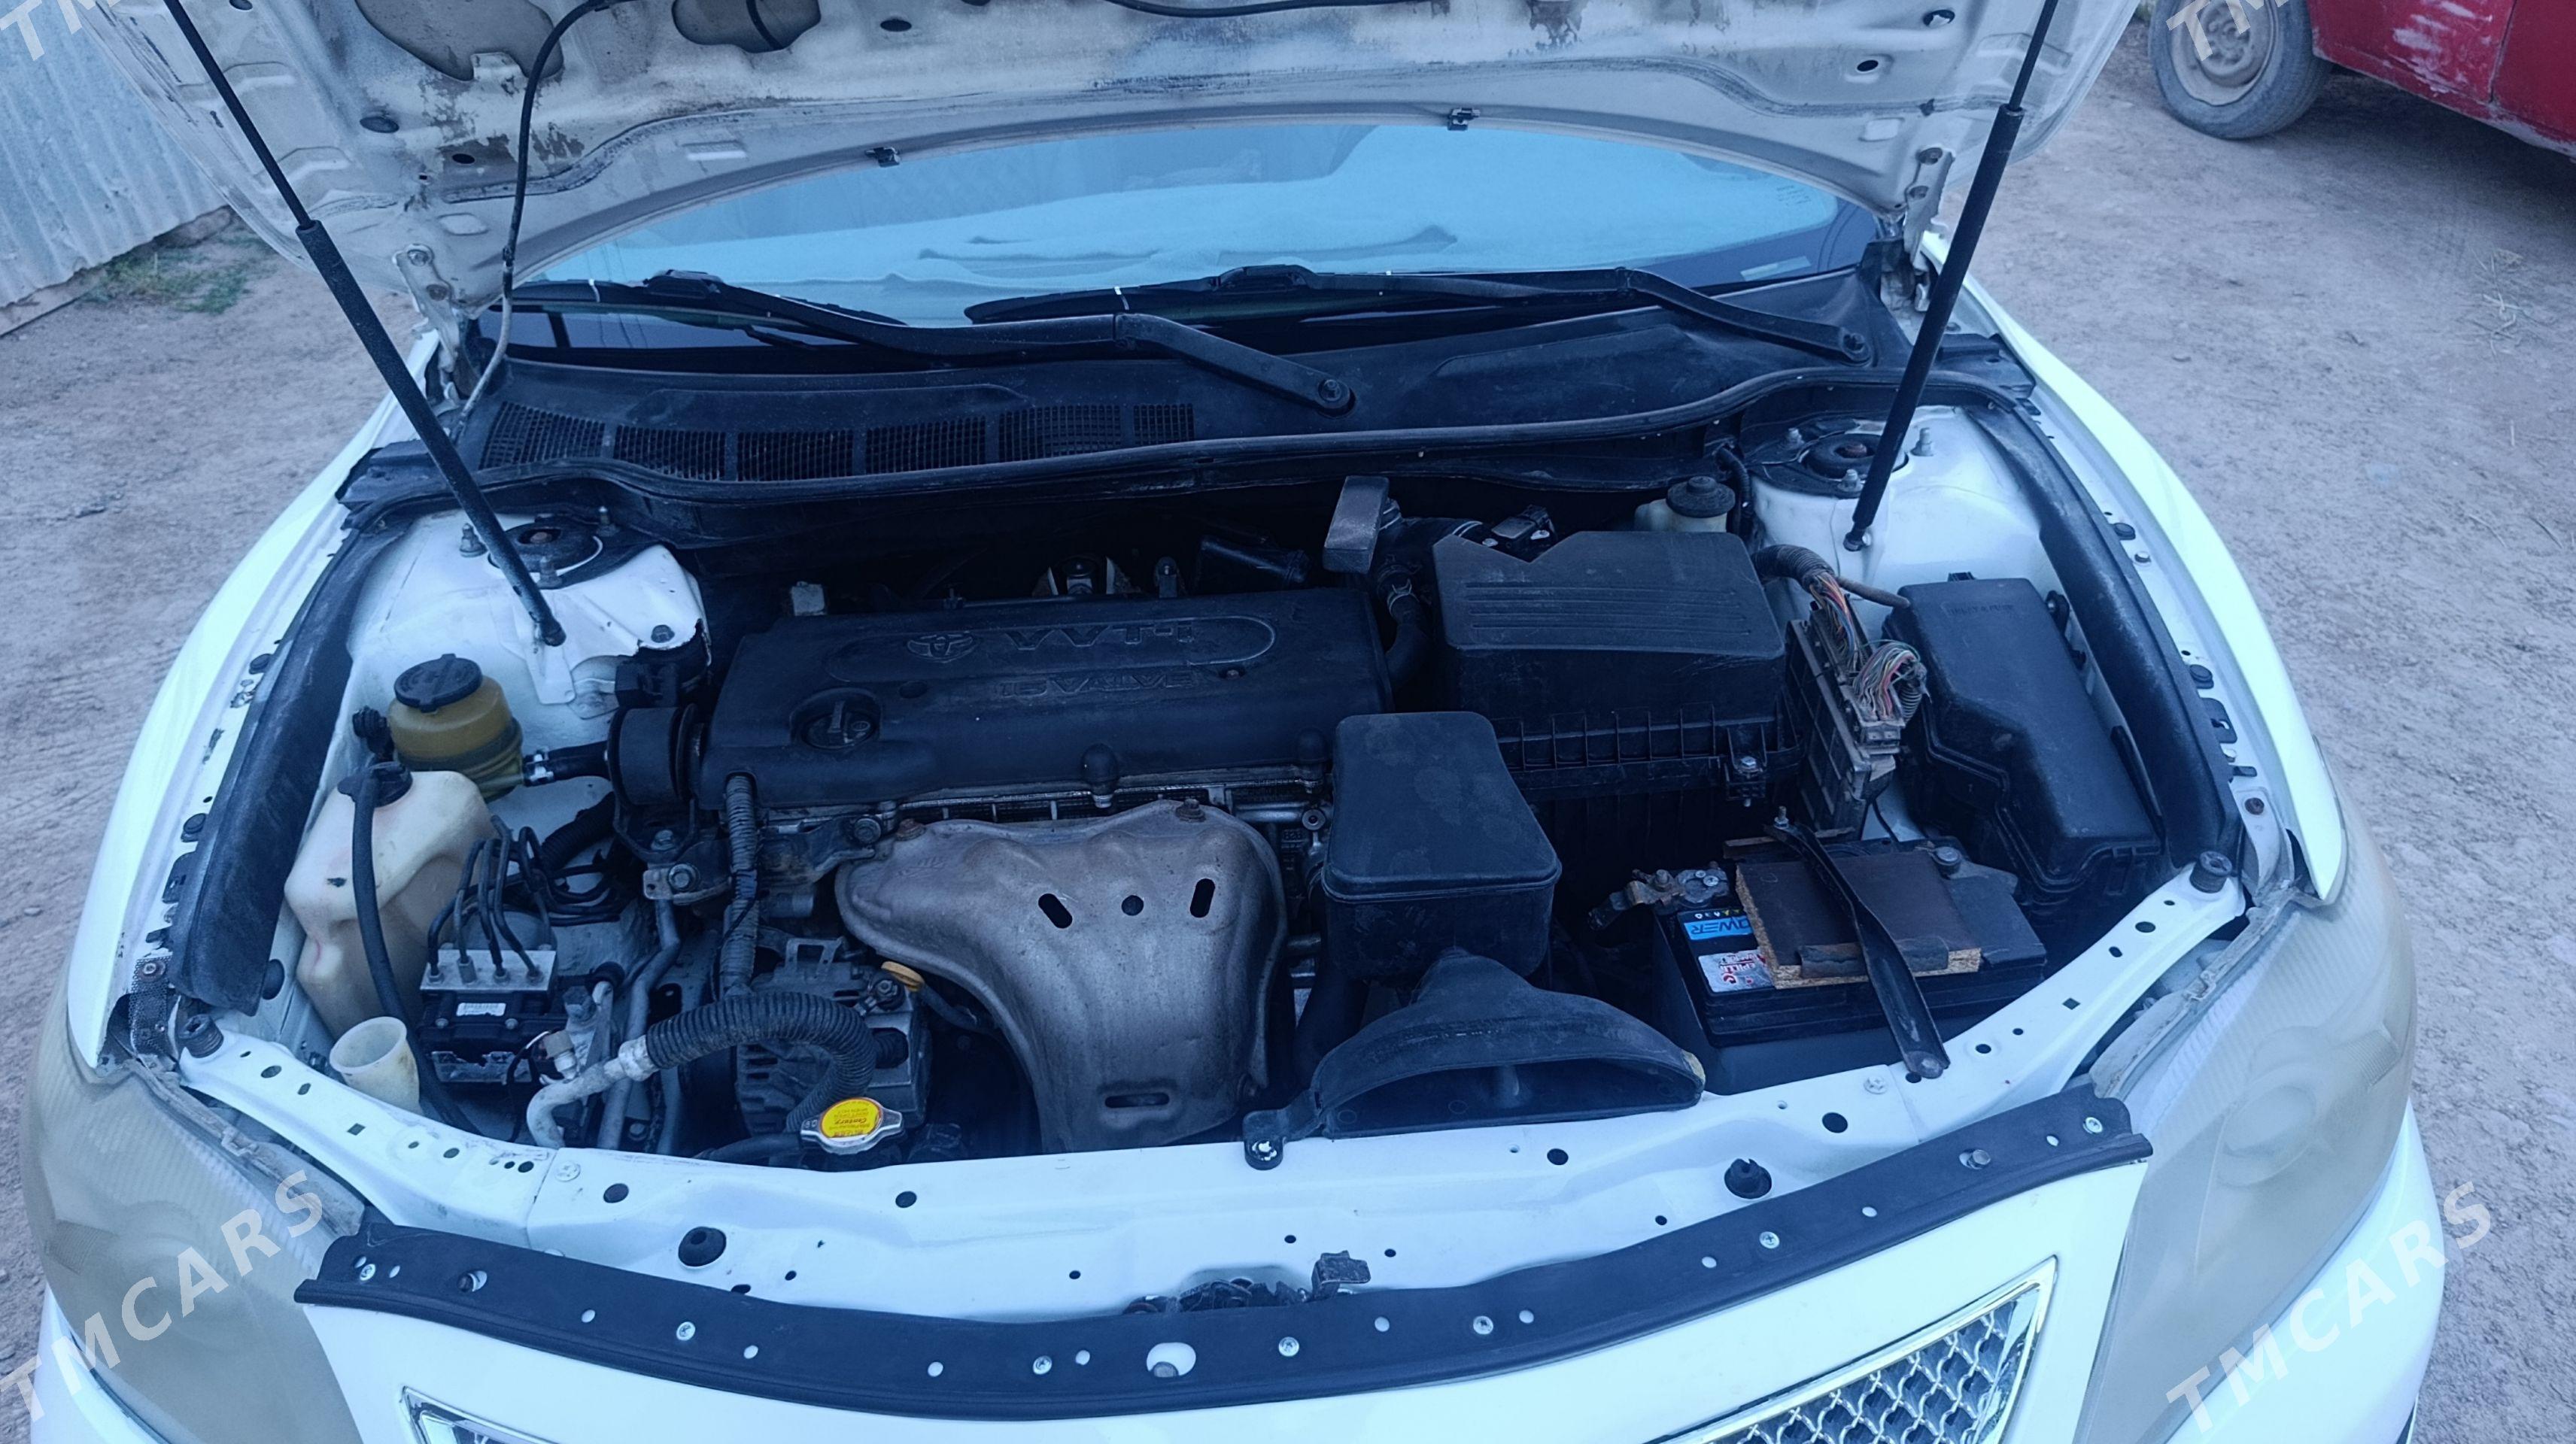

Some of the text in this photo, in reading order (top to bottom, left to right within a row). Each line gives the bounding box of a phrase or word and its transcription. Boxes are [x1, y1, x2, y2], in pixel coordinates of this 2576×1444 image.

[1005, 621, 1194, 650] VVT-i
[1051, 670, 1194, 696] VALVE
[1691, 917, 1750, 934] OWER
